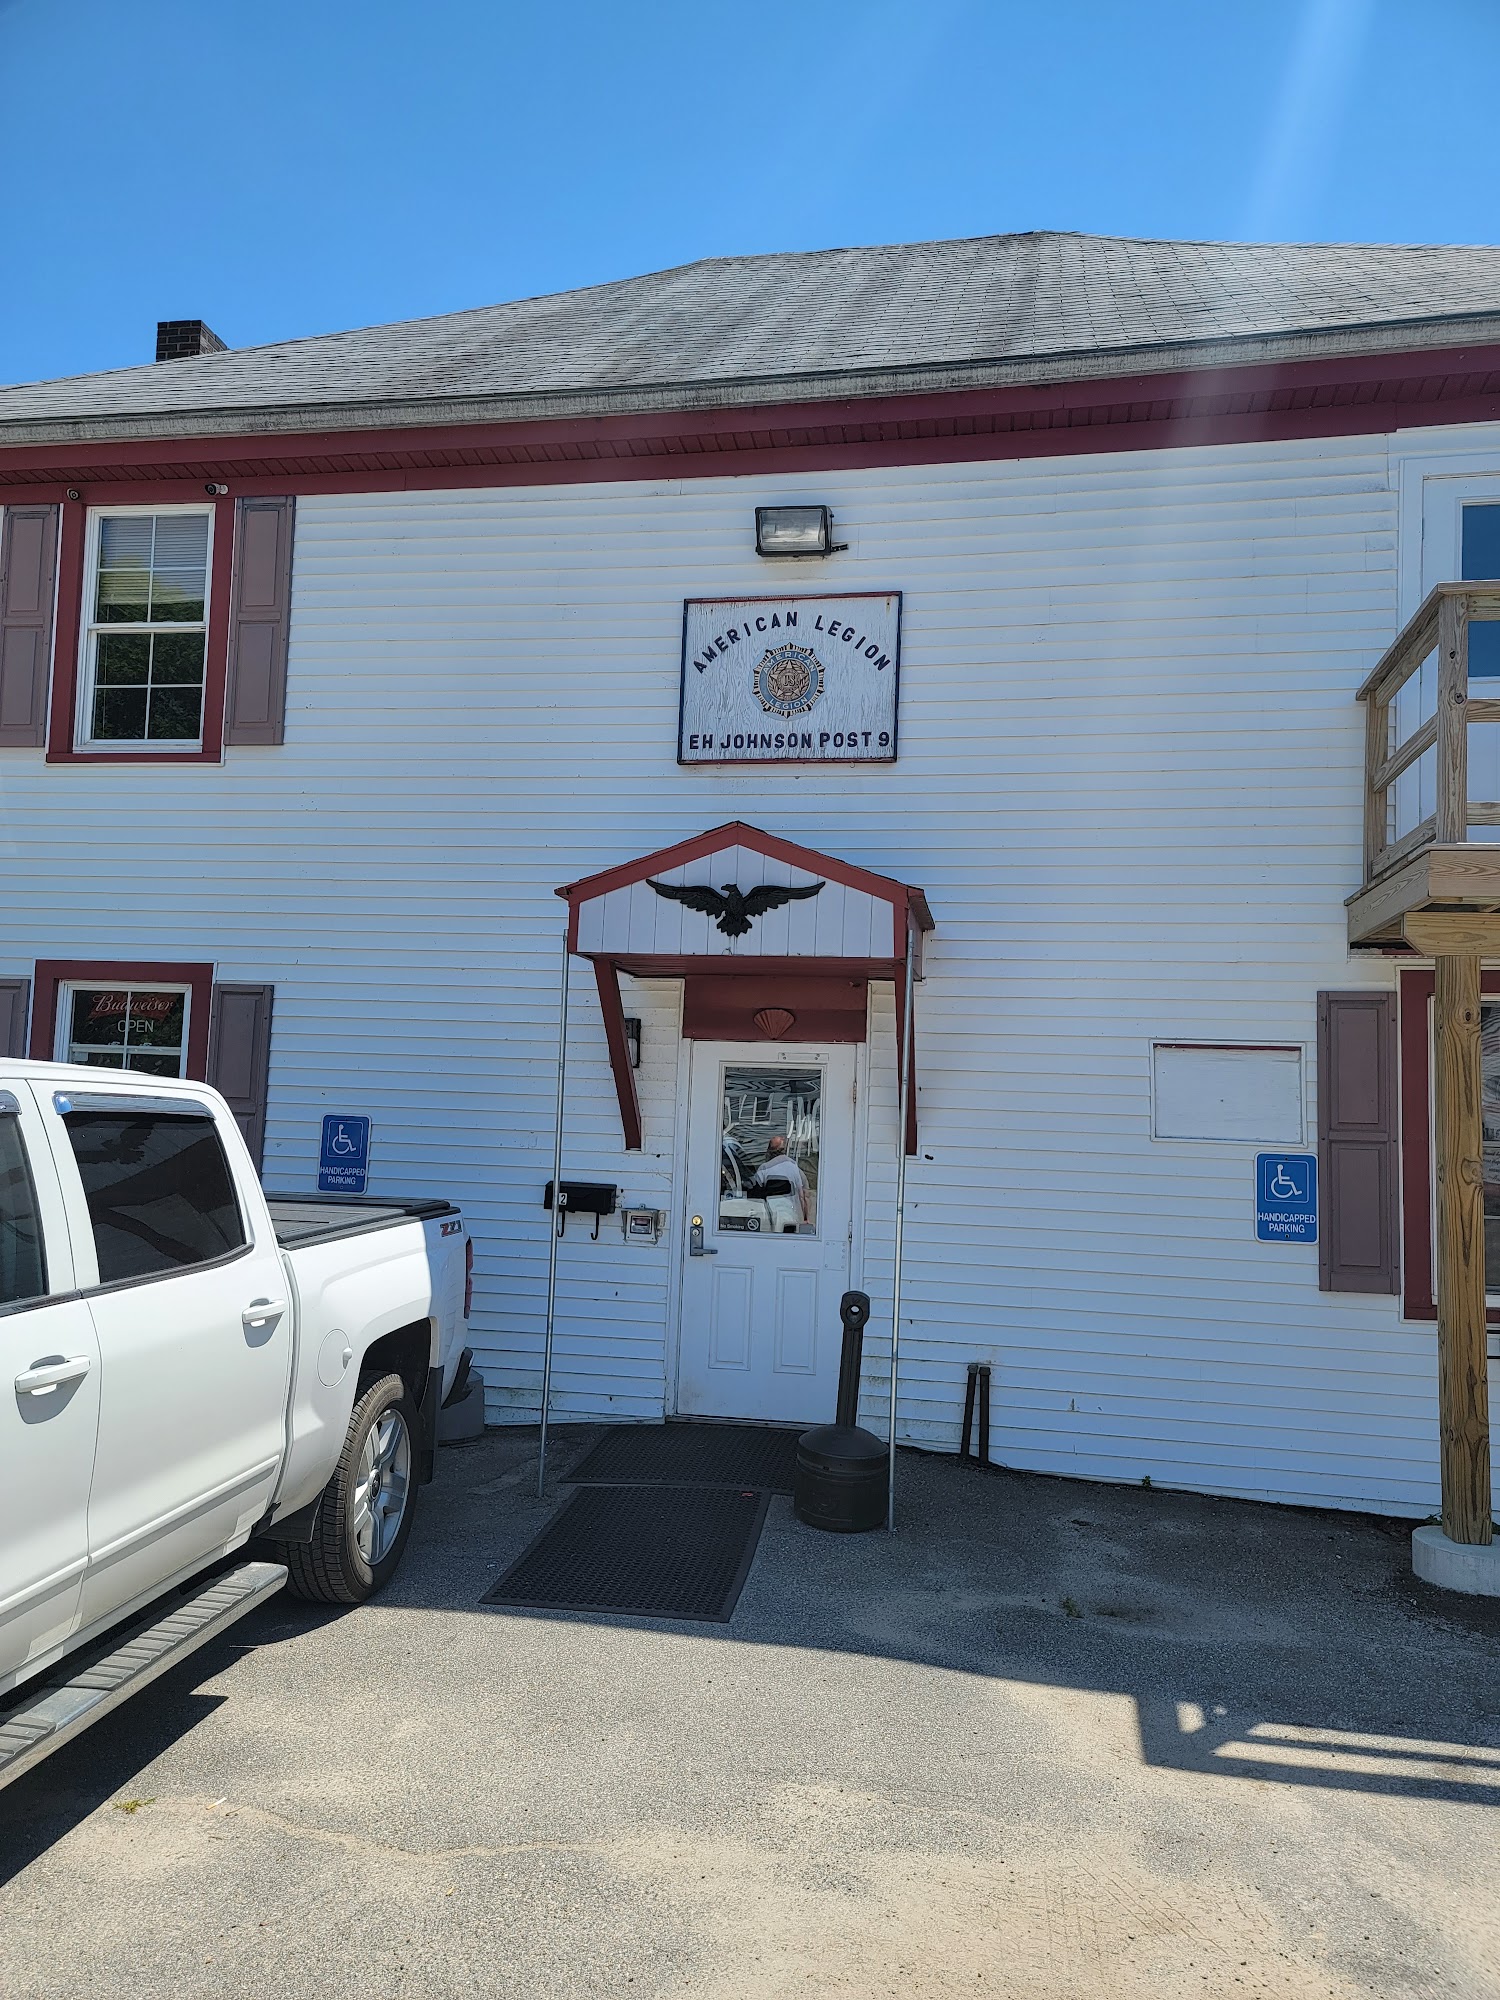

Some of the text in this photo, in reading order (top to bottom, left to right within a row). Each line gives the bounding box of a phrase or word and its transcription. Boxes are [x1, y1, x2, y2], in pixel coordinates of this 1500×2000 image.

[693, 611, 891, 674] AMERICAN LEGION
[763, 651, 816, 674] AMERICAN
[770, 696, 808, 710] LEGION
[689, 731, 890, 750] EH JOHNSON POST 9
[92, 994, 174, 1012] Budweiser
[117, 1019, 154, 1033] OPEN
[320, 1166, 366, 1176] HANDICAPPED
[327, 1175, 357, 1185] PARKING
[561, 1194, 566, 1205] 2
[1257, 1212, 1316, 1224] HANDICAPPED
[440, 1219, 462, 1238] Z71
[1268, 1222, 1305, 1234] PARKING
